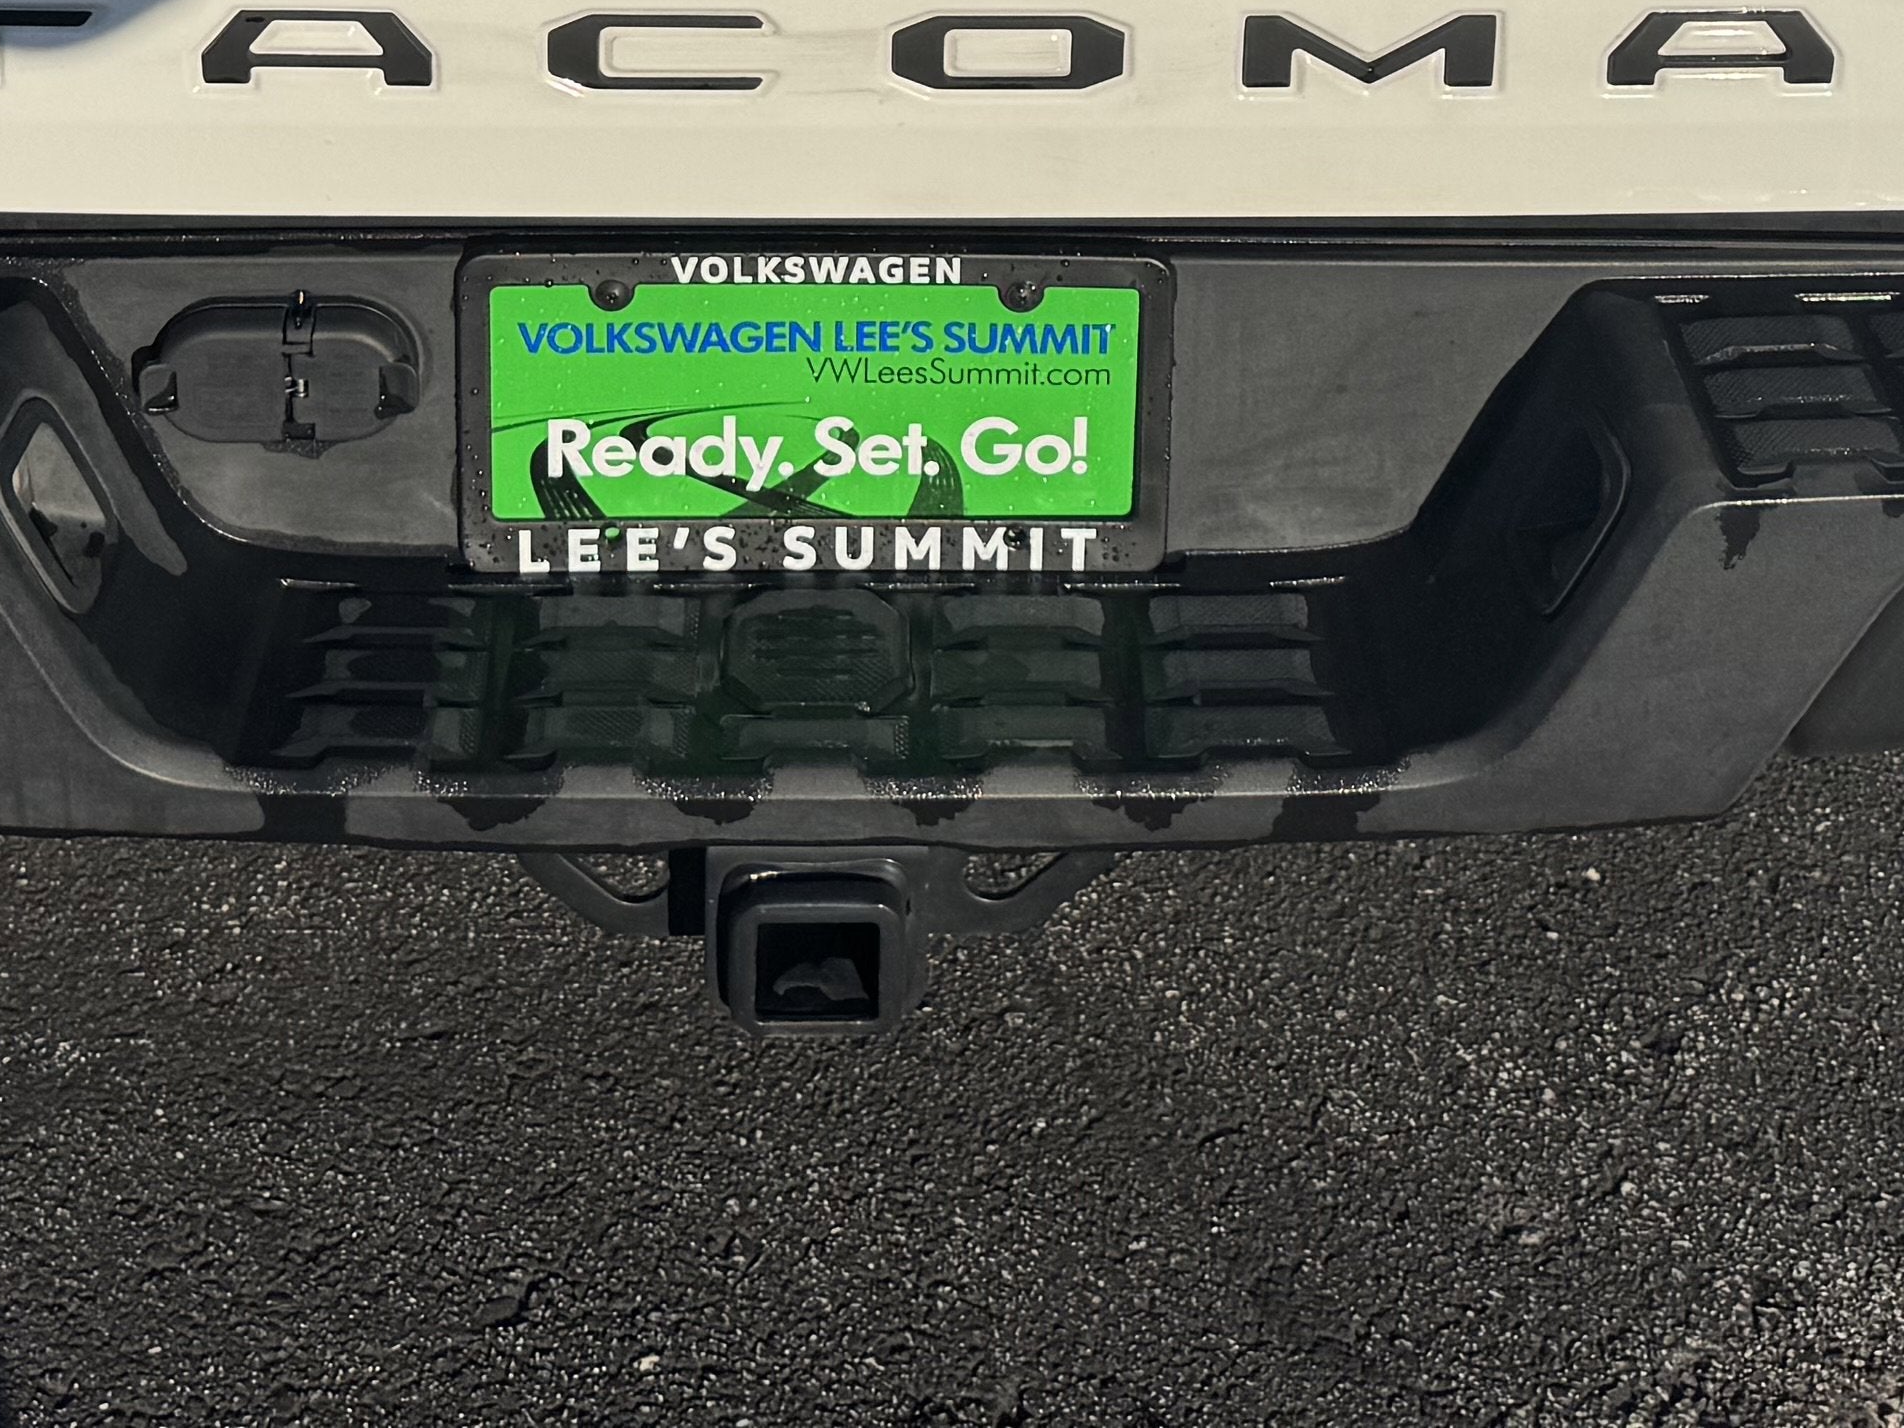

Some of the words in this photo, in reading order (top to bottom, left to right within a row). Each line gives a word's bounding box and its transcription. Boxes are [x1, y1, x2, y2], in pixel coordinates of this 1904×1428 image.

[670, 256, 963, 285] VOLKSWAGEN
[516, 321, 823, 355] VOLKSWAGEN
[834, 320, 934, 353] LEE'S
[943, 322, 1116, 356] SUMMIT
[806, 357, 1112, 388] VWLeesSummit.com
[546, 416, 795, 491] Ready.
[813, 417, 940, 477] Set.
[960, 417, 1090, 477] Go!
[518, 528, 738, 575] LEE'S
[783, 527, 1096, 573] SUMMIT
